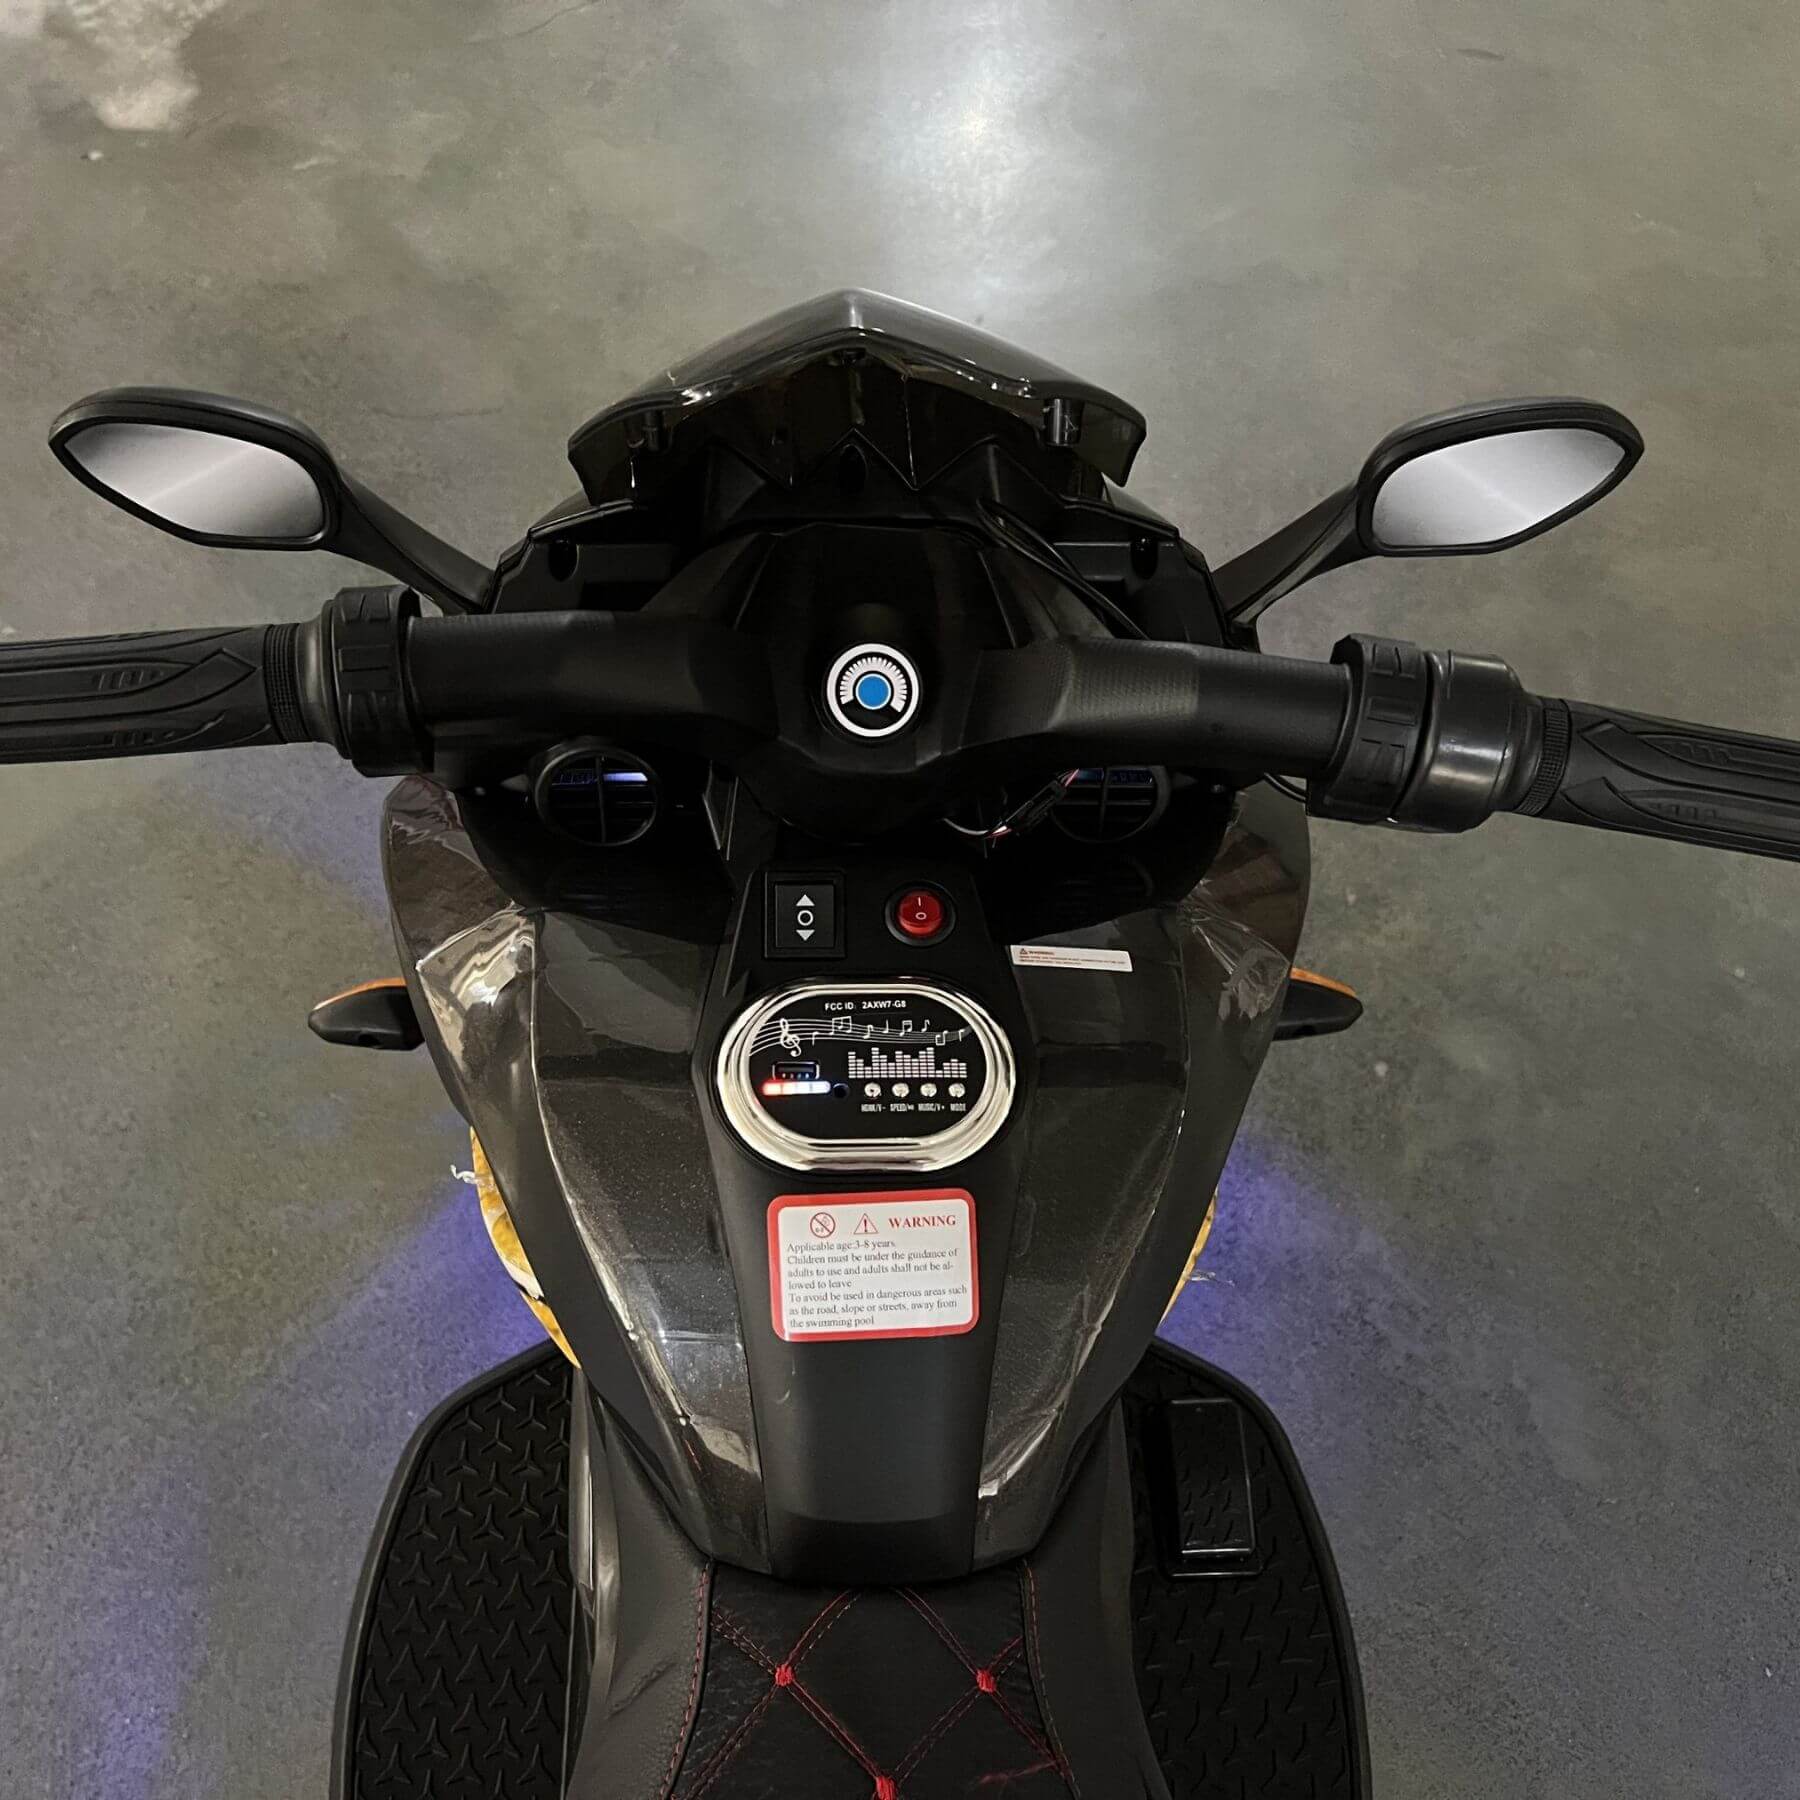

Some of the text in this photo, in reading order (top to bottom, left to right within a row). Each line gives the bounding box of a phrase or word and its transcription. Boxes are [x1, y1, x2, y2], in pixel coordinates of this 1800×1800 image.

[824, 1002, 843, 1011] FCC
[861, 1000, 907, 1009] 2AXW7-G8
[888, 1214, 956, 1228] WARNING
[788, 1241, 834, 1254] Applicable
[788, 1247, 959, 1265] Children must be under the guidance of
[788, 1268, 814, 1277] adults
[816, 1268, 825, 1276] to
[844, 1265, 860, 1275] and
[862, 1264, 889, 1274] adults
[891, 1263, 911, 1272] shall
[914, 1263, 927, 1271] not
[930, 1262, 940, 1271] be
[943, 1261, 954, 1270] al-
[788, 1279, 852, 1290] lowed to leave
[788, 1285, 967, 1303] To avoid be used in dangerous areas such
[789, 1307, 799, 1315] as
[801, 1305, 815, 1315] the
[841, 1303, 865, 1315] slope
[911, 1301, 934, 1311] away
[937, 1299, 958, 1309] from
[790, 1315, 876, 1329] the swimming pool
